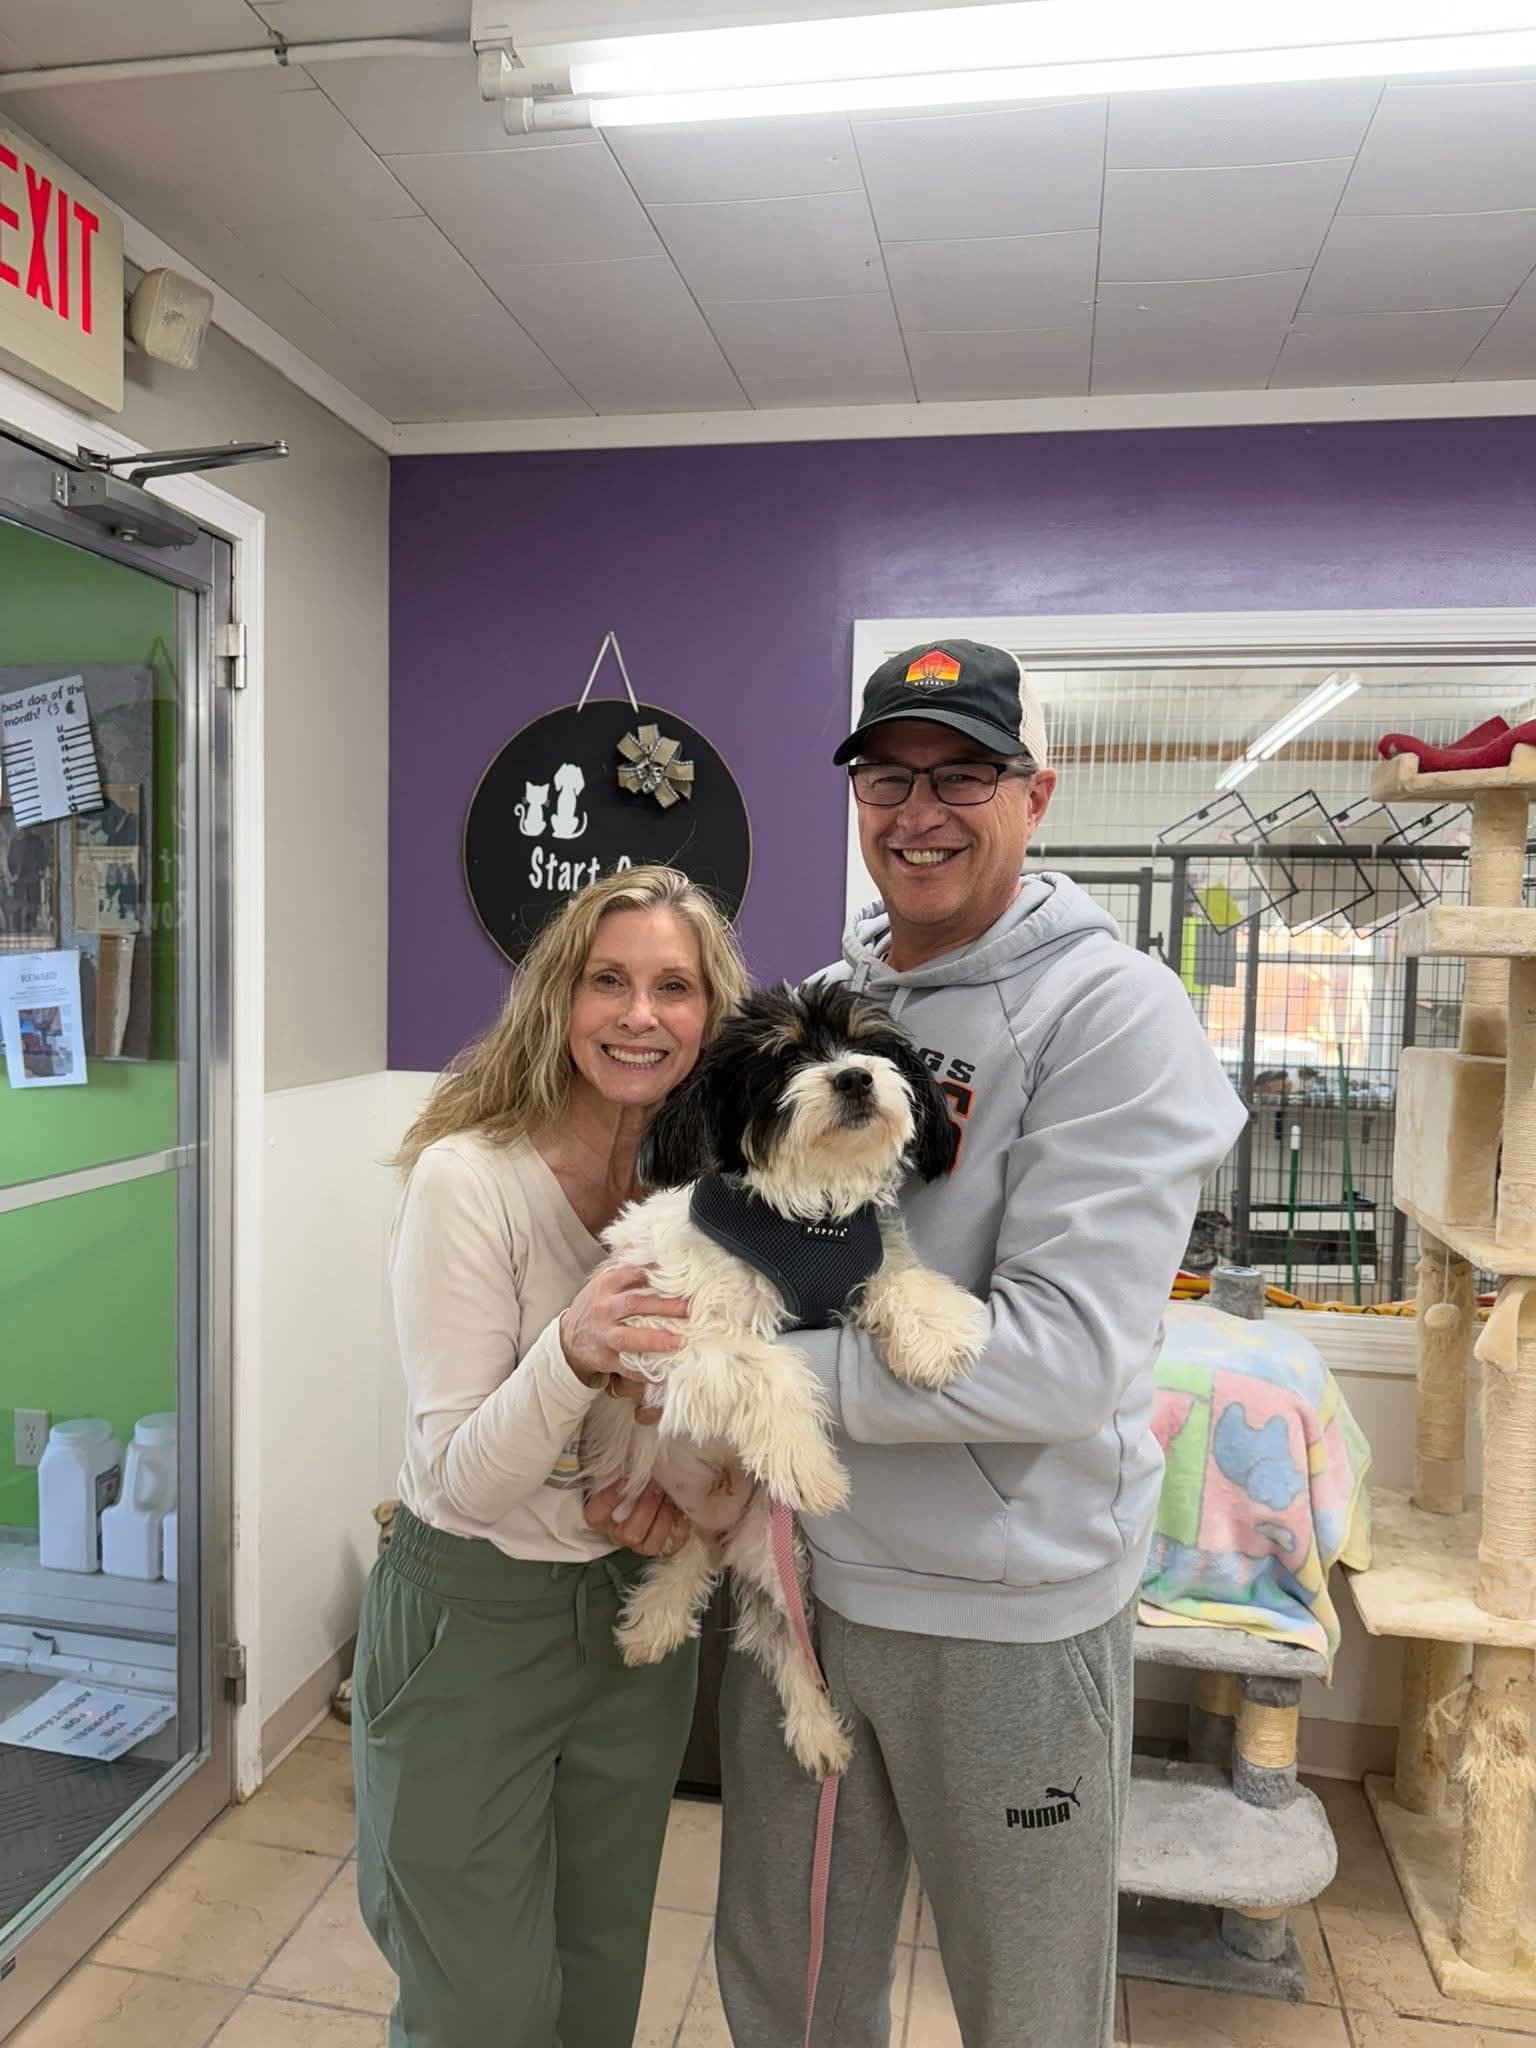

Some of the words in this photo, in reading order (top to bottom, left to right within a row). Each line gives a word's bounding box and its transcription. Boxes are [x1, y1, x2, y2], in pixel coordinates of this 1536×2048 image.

[0, 143, 99, 335] EXIT
[2, 699, 23, 712] best
[27, 694, 48, 704] dog
[51, 685, 63, 699] of
[4, 707, 40, 727] month!
[528, 846, 600, 891] Start
[807, 1226, 845, 1237] PUPPIA
[1006, 1801, 1070, 1829] PUMA
